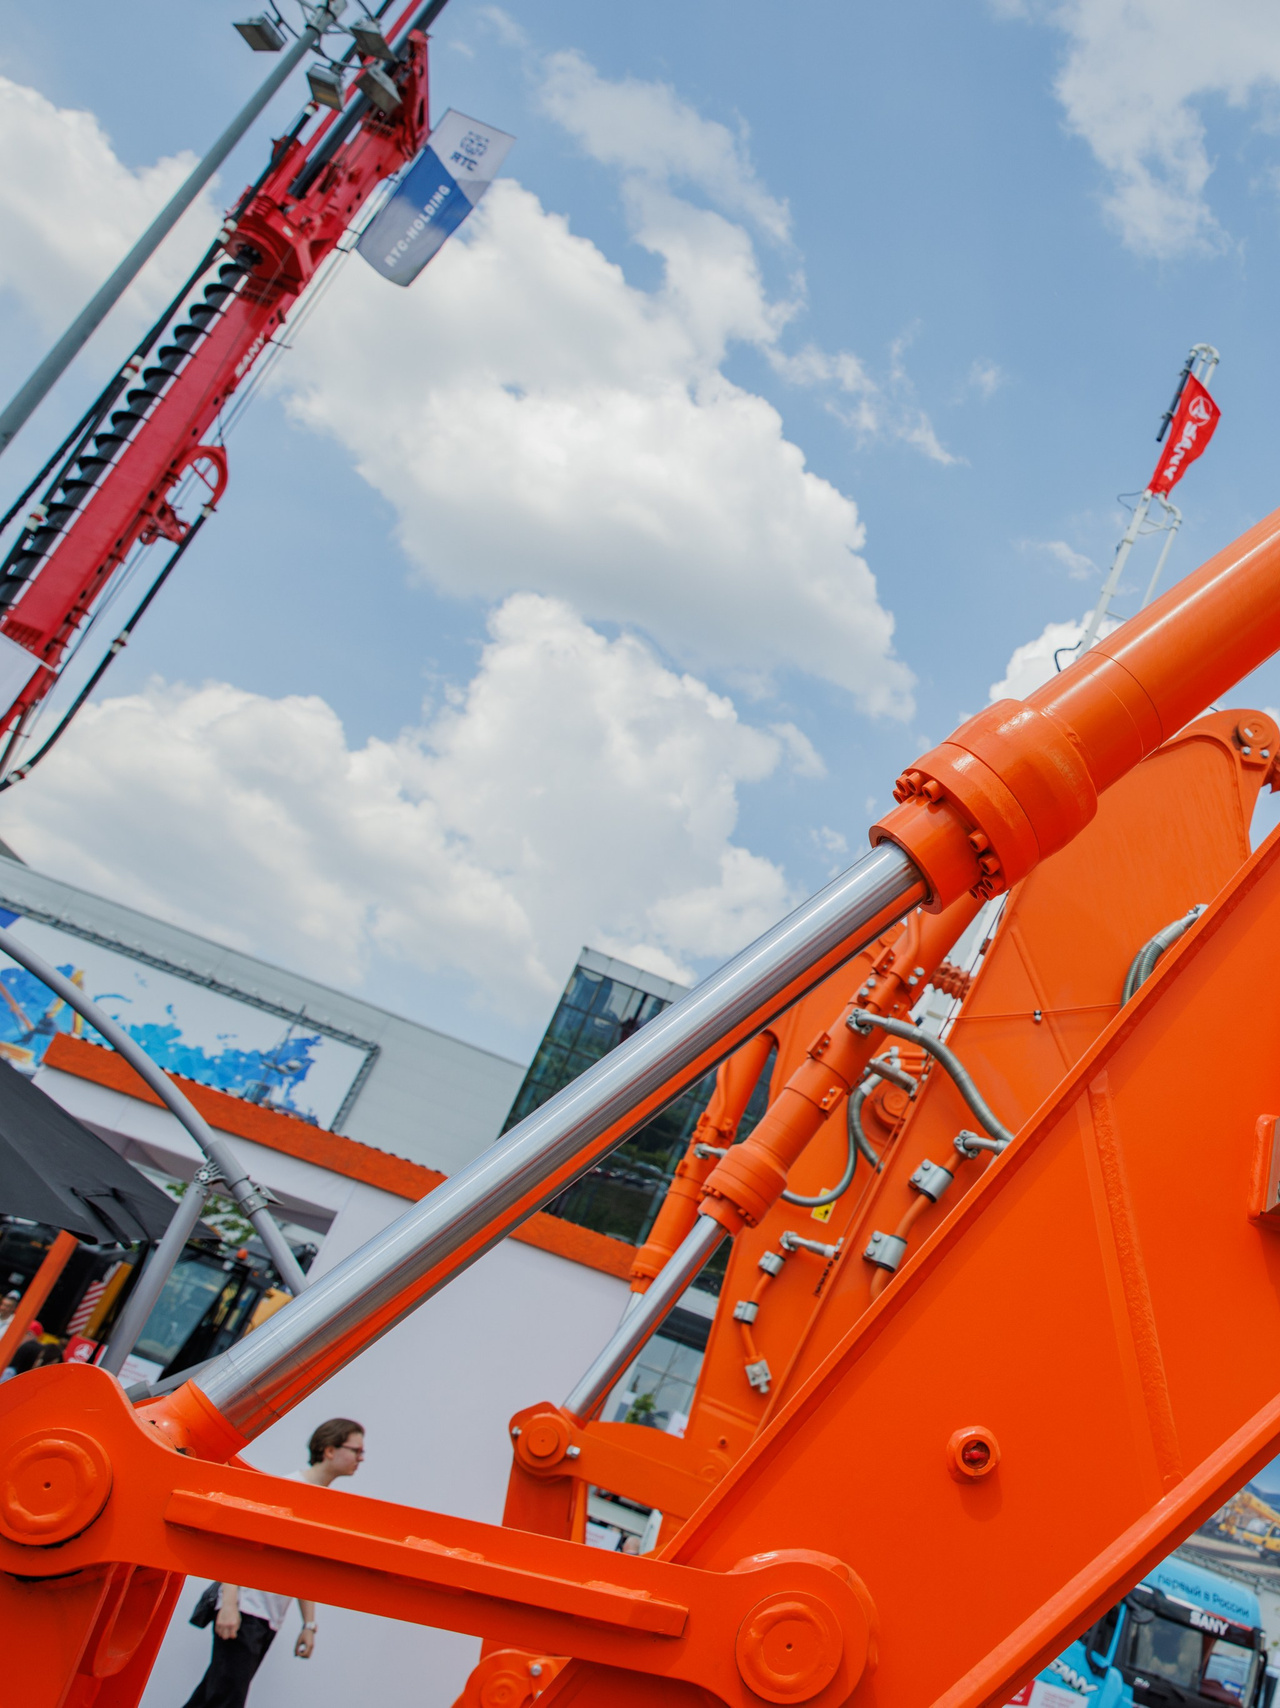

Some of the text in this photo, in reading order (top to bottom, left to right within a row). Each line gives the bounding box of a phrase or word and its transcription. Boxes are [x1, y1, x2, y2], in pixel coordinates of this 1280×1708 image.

[234, 331, 265, 379] SANY
[1163, 420, 1198, 481] SANY
[1189, 1610, 1229, 1636] SANY
[1212, 1592, 1250, 1618] России
